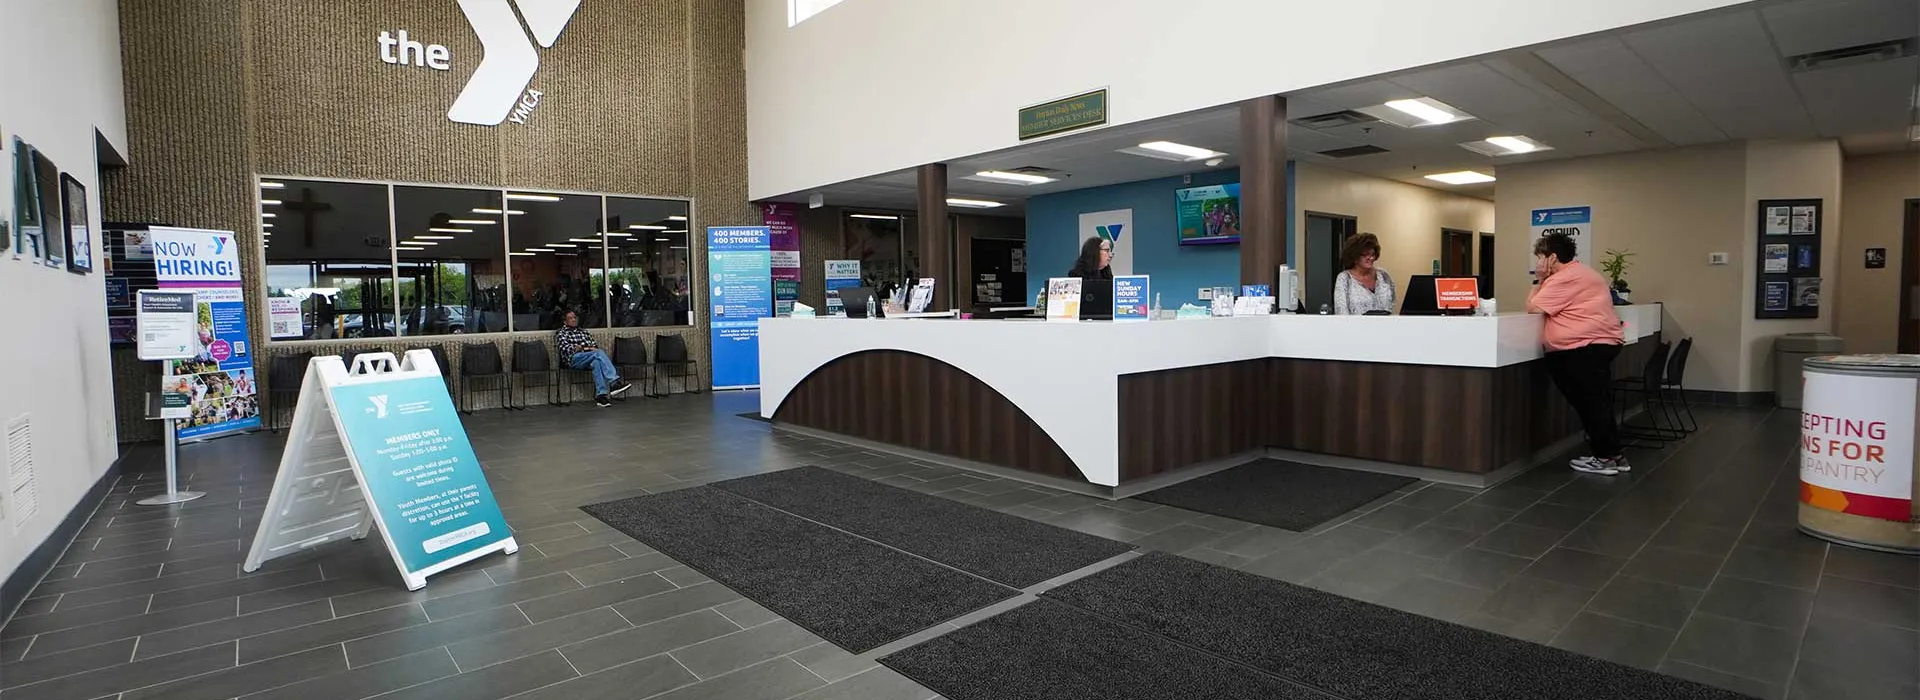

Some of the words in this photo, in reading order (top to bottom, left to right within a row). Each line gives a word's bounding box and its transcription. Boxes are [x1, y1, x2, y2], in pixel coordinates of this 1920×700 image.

[378, 30, 450, 70] the
[509, 88, 543, 125] YMCA
[154, 241, 196, 257] NOW
[157, 259, 234, 276] HIRING!
[385, 431, 422, 445] MEMBERS
[422, 428, 440, 438] ONLY
[390, 452, 411, 461] Sunday
[1828, 439, 1886, 464] FOR
[392, 467, 413, 477] Guests
[412, 464, 425, 473] with
[425, 461, 437, 469] valid
[1807, 456, 1886, 484] PANTRY
[415, 478, 435, 488] limited
[397, 500, 414, 510] Youth
[447, 487, 459, 495] their
[450, 495, 460, 503] the
[408, 516, 418, 524] for
[438, 506, 454, 515] hours
